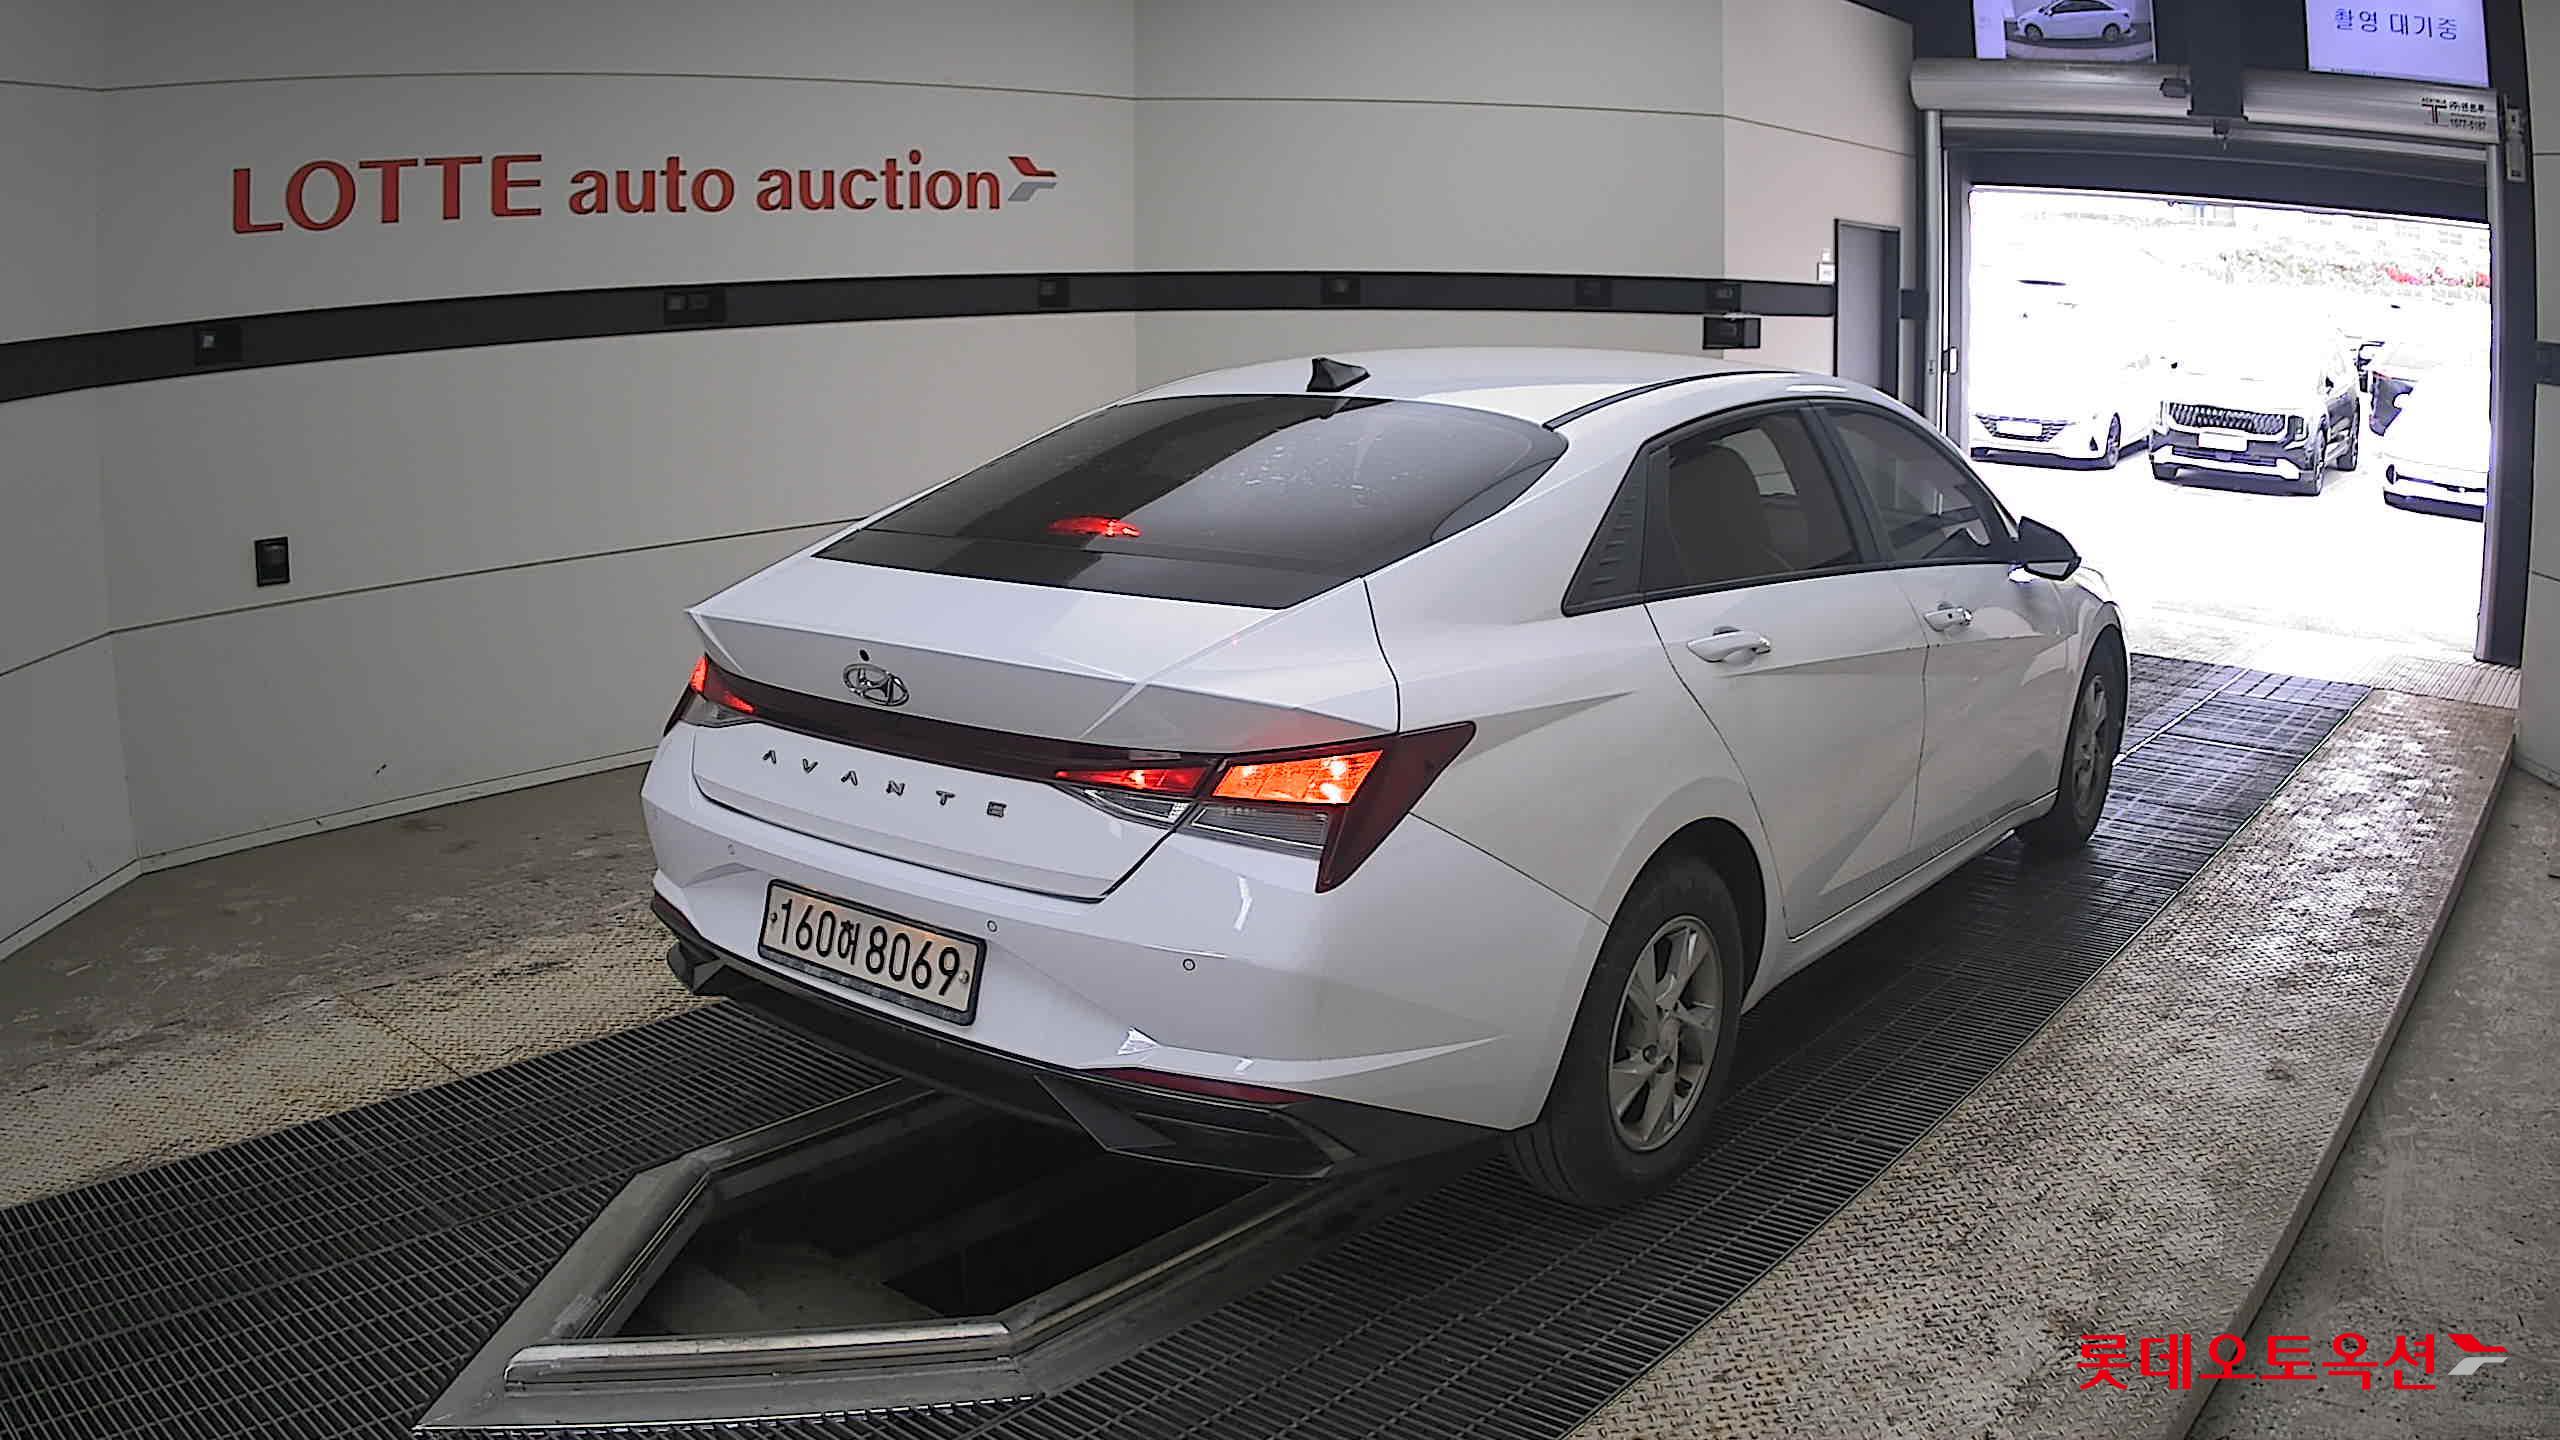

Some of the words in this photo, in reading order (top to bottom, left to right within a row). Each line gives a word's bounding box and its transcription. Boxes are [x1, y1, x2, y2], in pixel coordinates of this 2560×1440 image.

[2335, 8, 2378, 33] 촬영
[2390, 13, 2457, 40] 대기중
[233, 155, 542, 234] LOTTE
[569, 157, 736, 214] auto
[757, 150, 1002, 211] auction
[763, 750, 1007, 817] AVANTE
